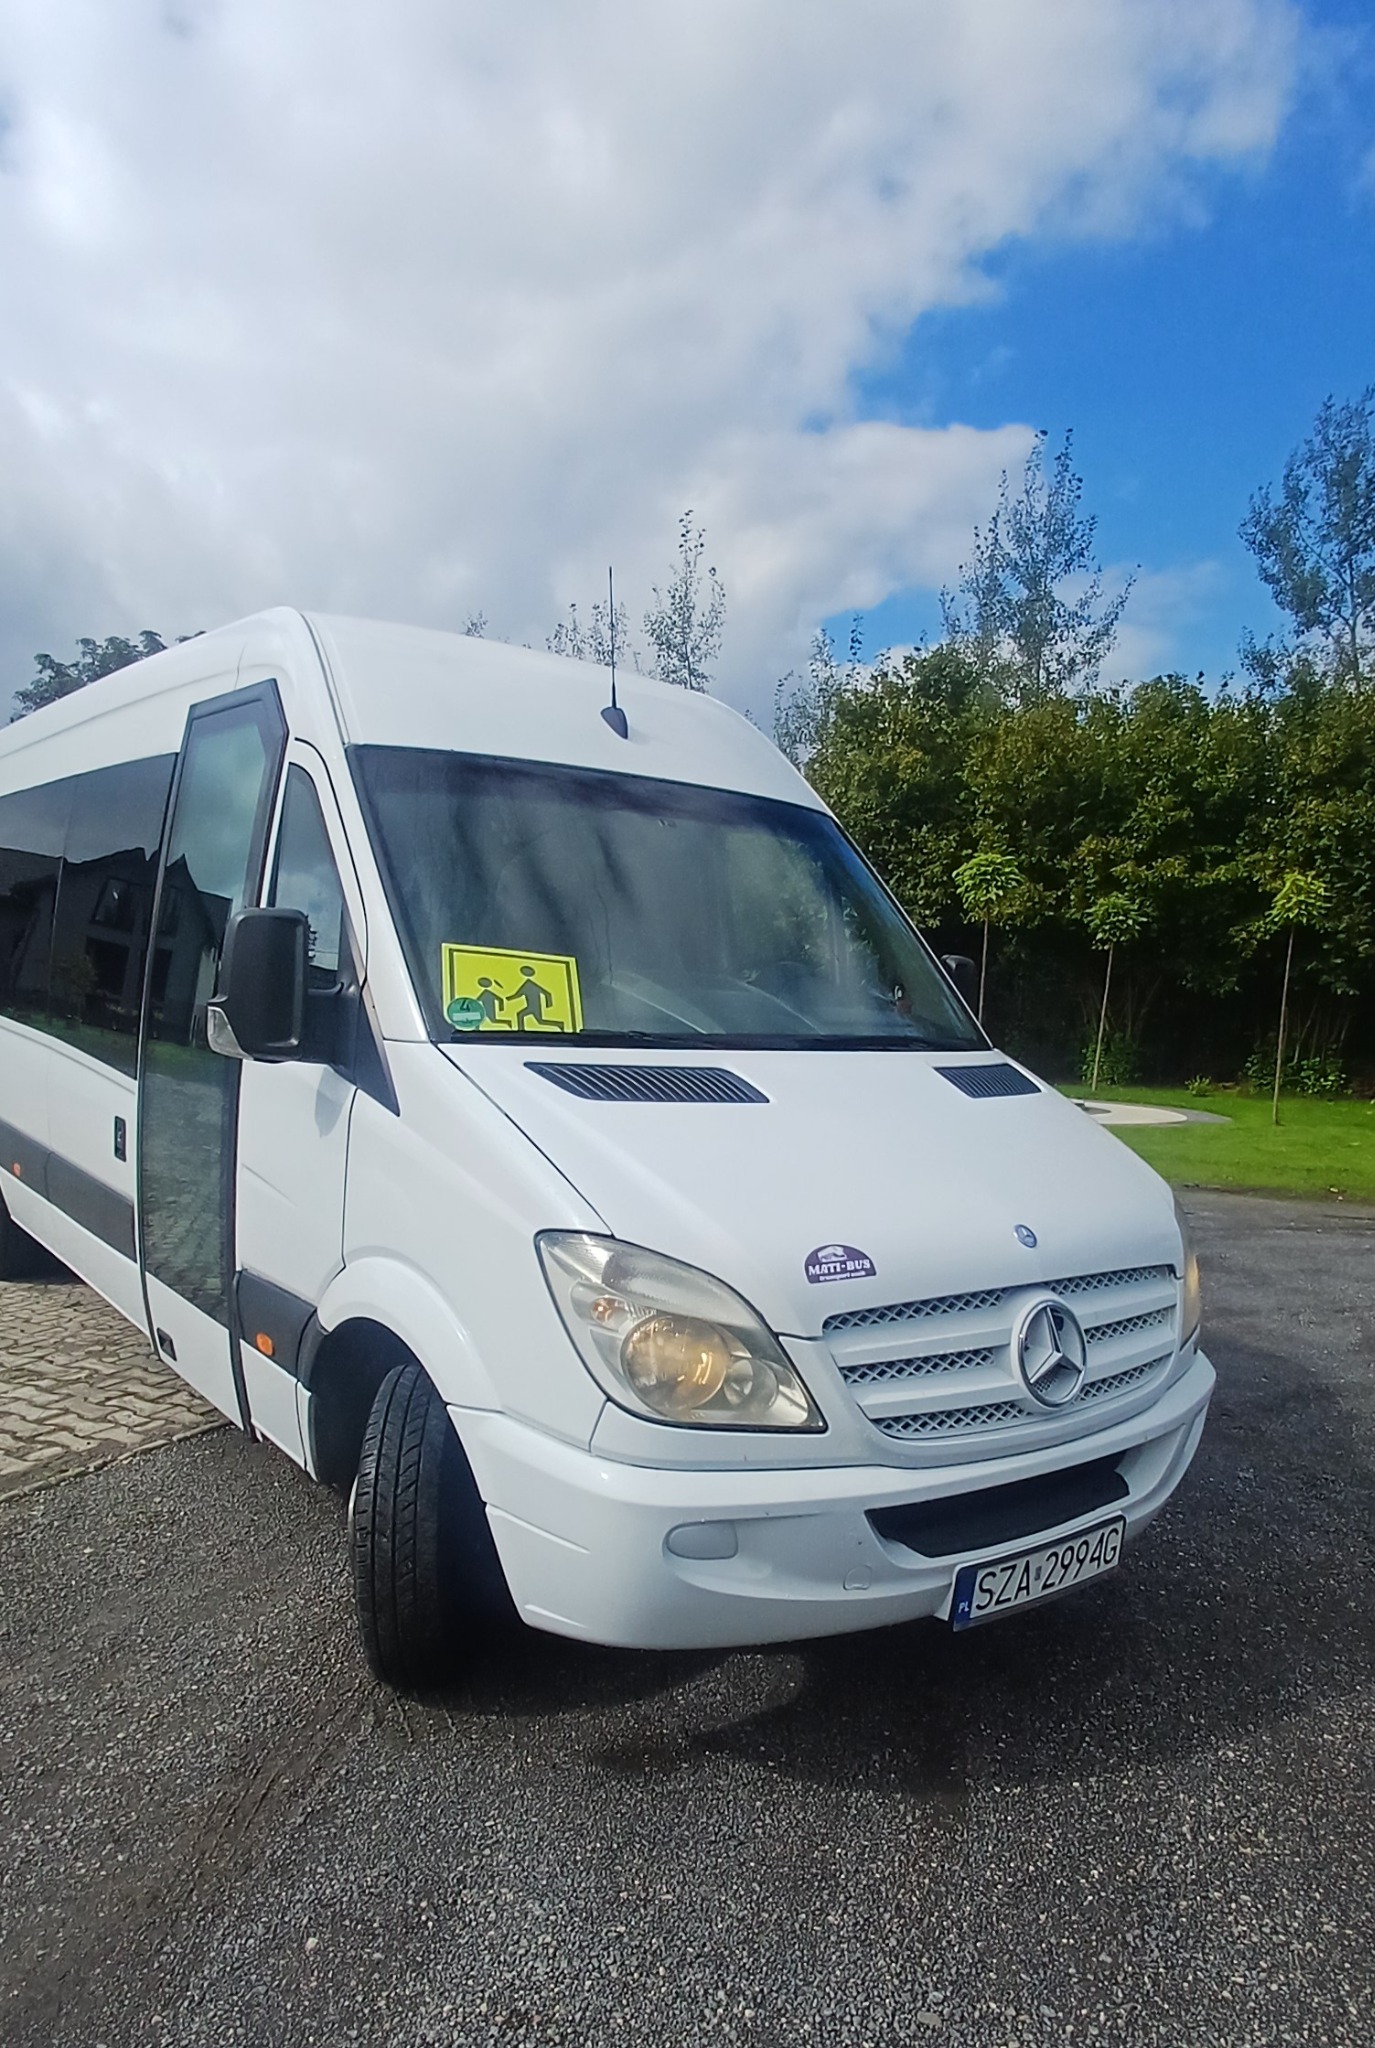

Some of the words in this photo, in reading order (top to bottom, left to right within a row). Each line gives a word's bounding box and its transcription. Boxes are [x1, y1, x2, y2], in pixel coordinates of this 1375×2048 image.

[460, 999, 471, 1012] 4
[808, 1259, 871, 1276] MATI-BUS
[976, 1559, 1031, 1611] SZA
[1041, 1527, 1119, 1592] 2994G
[958, 1601, 970, 1613] PL
